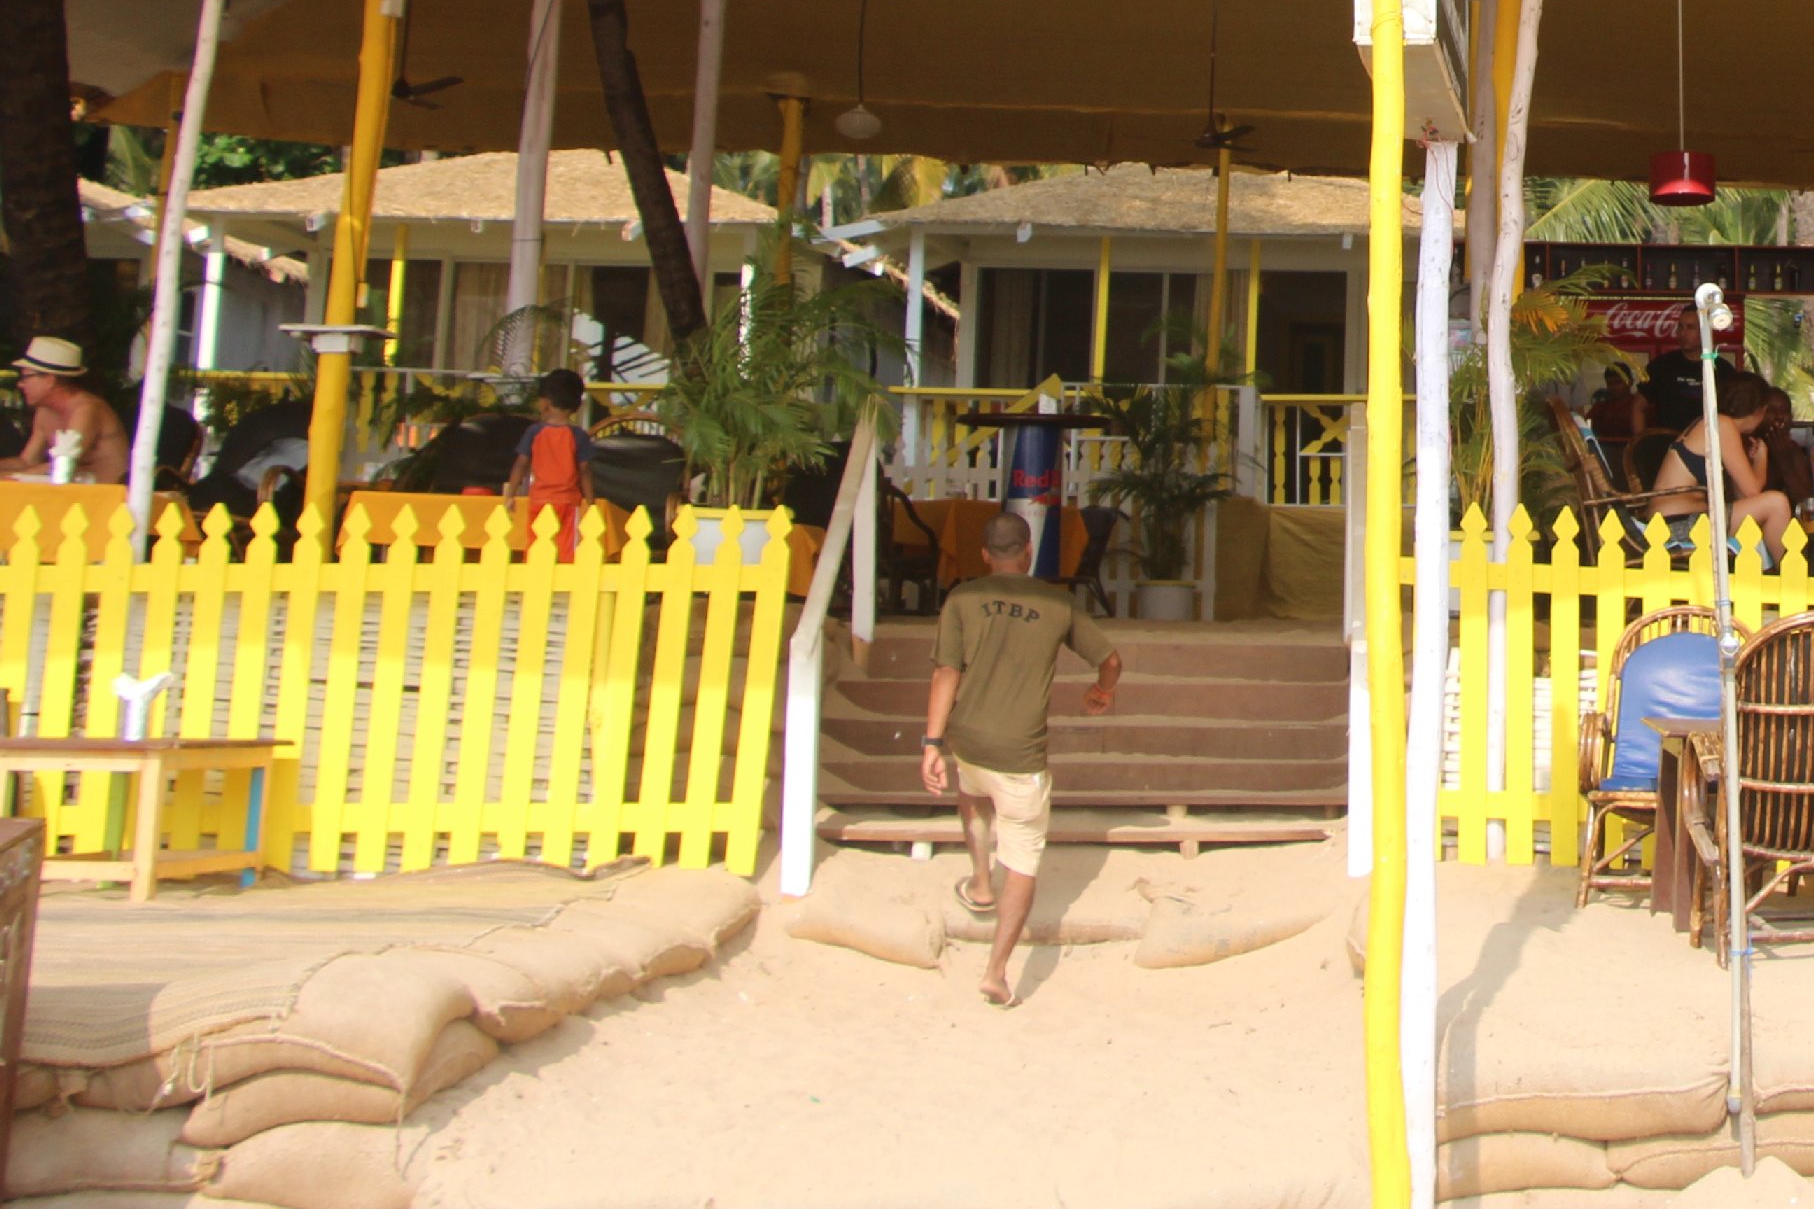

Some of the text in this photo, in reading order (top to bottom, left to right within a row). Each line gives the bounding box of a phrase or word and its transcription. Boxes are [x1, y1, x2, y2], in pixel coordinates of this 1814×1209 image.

[1602, 302, 1690, 338] Coca-C
[1013, 469, 1049, 488] Red
[981, 600, 1041, 623] ITBP
